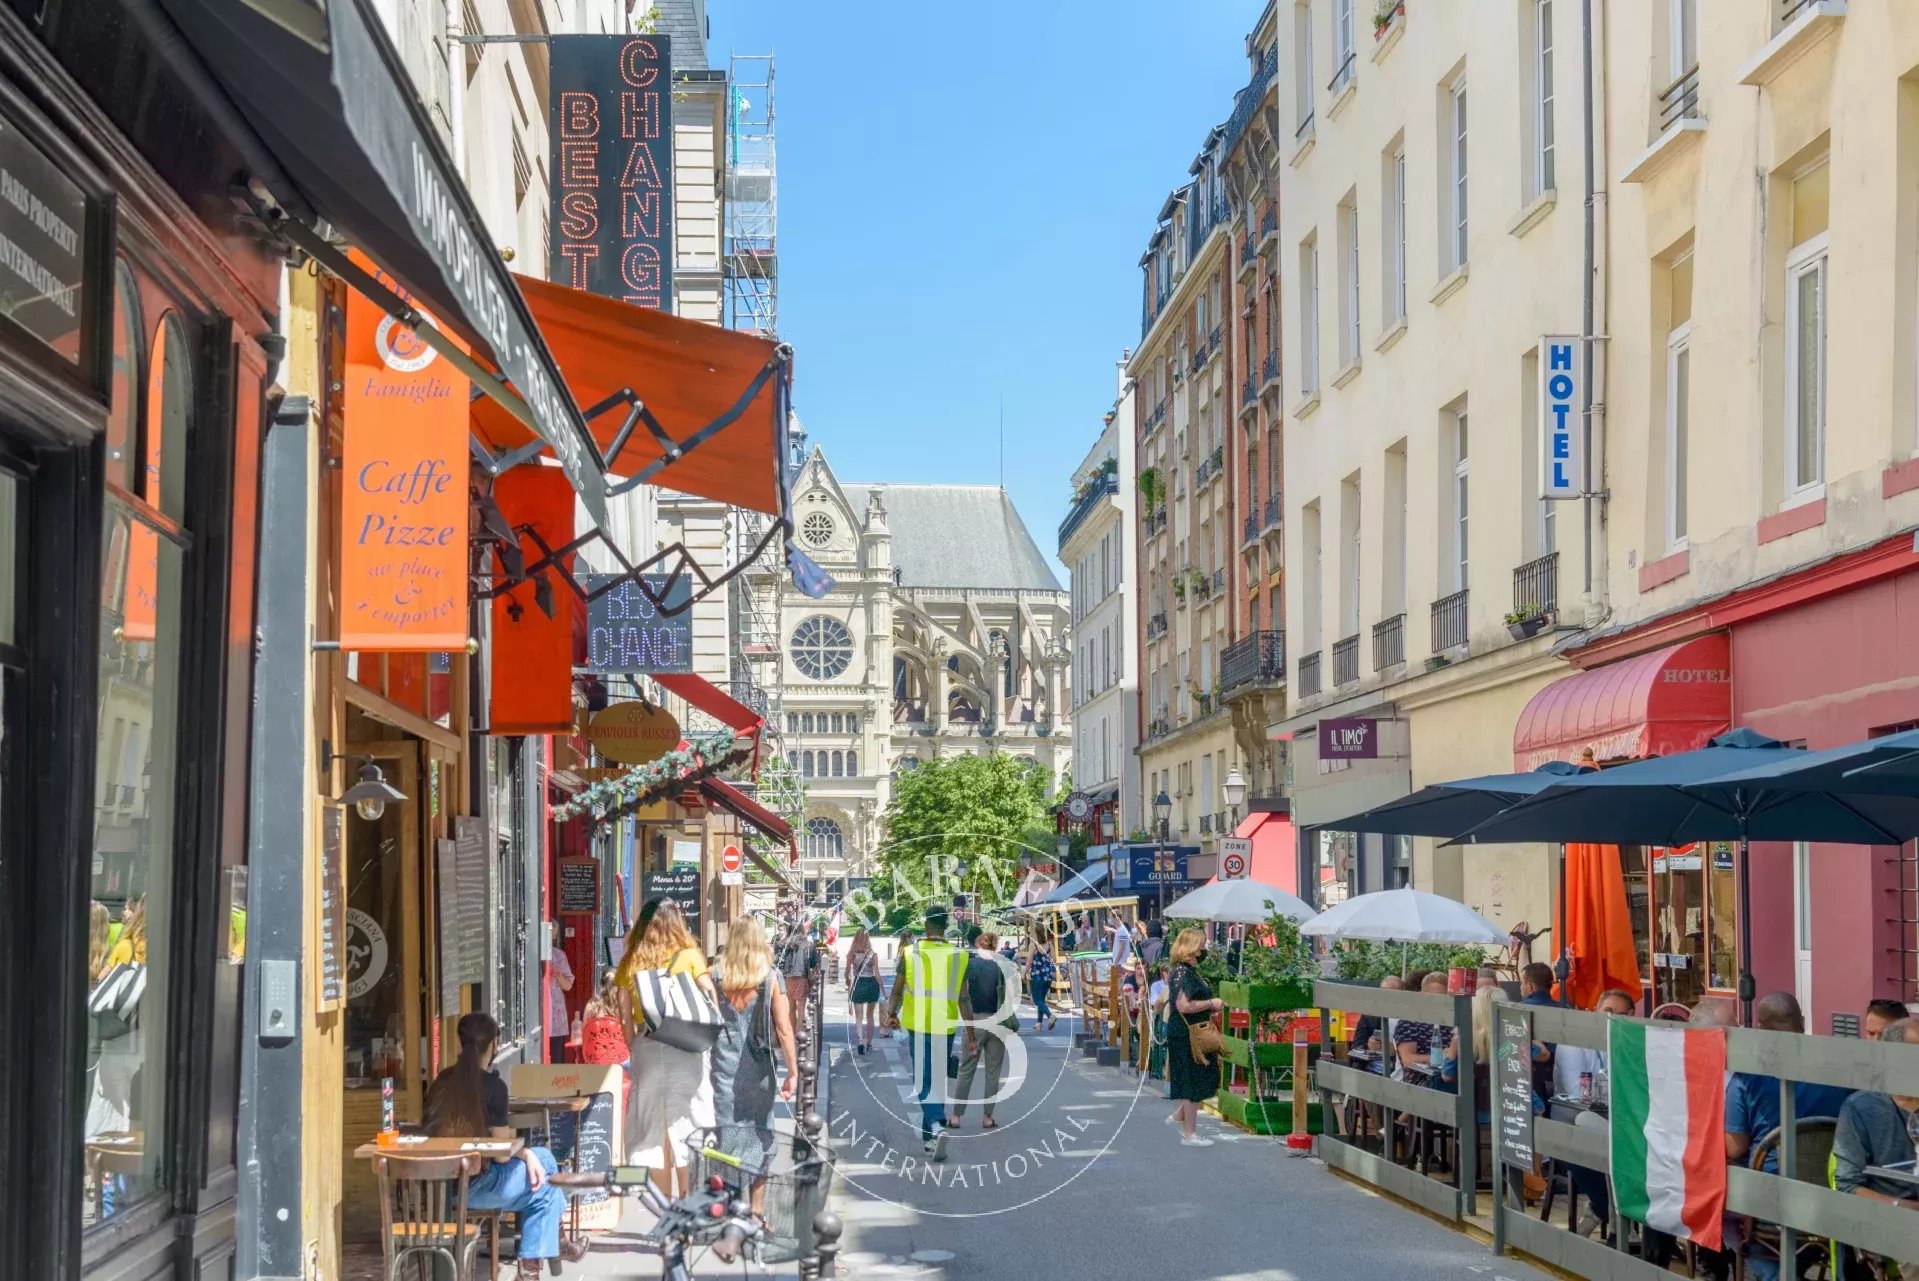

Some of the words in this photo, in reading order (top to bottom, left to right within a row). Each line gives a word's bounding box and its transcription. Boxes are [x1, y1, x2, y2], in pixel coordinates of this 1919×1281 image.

[620, 40, 662, 311] CHANG
[560, 92, 600, 290] BEST
[412, 141, 512, 361] IMMOBILIER
[364, 377, 450, 403] Famiglia
[1549, 345, 1573, 487] HOTEL
[357, 459, 452, 505] Caffe
[357, 513, 455, 546] Pizze
[399, 556, 445, 579] place
[371, 595, 457, 629] emporter
[1663, 669, 1730, 683] HOTEL
[1330, 729, 1338, 746] IL
[1341, 729, 1364, 745] TIMO
[1225, 842, 1247, 851] ZONE
[1148, 871, 1182, 880] GOARD
[1228, 860, 1241, 870] 30
